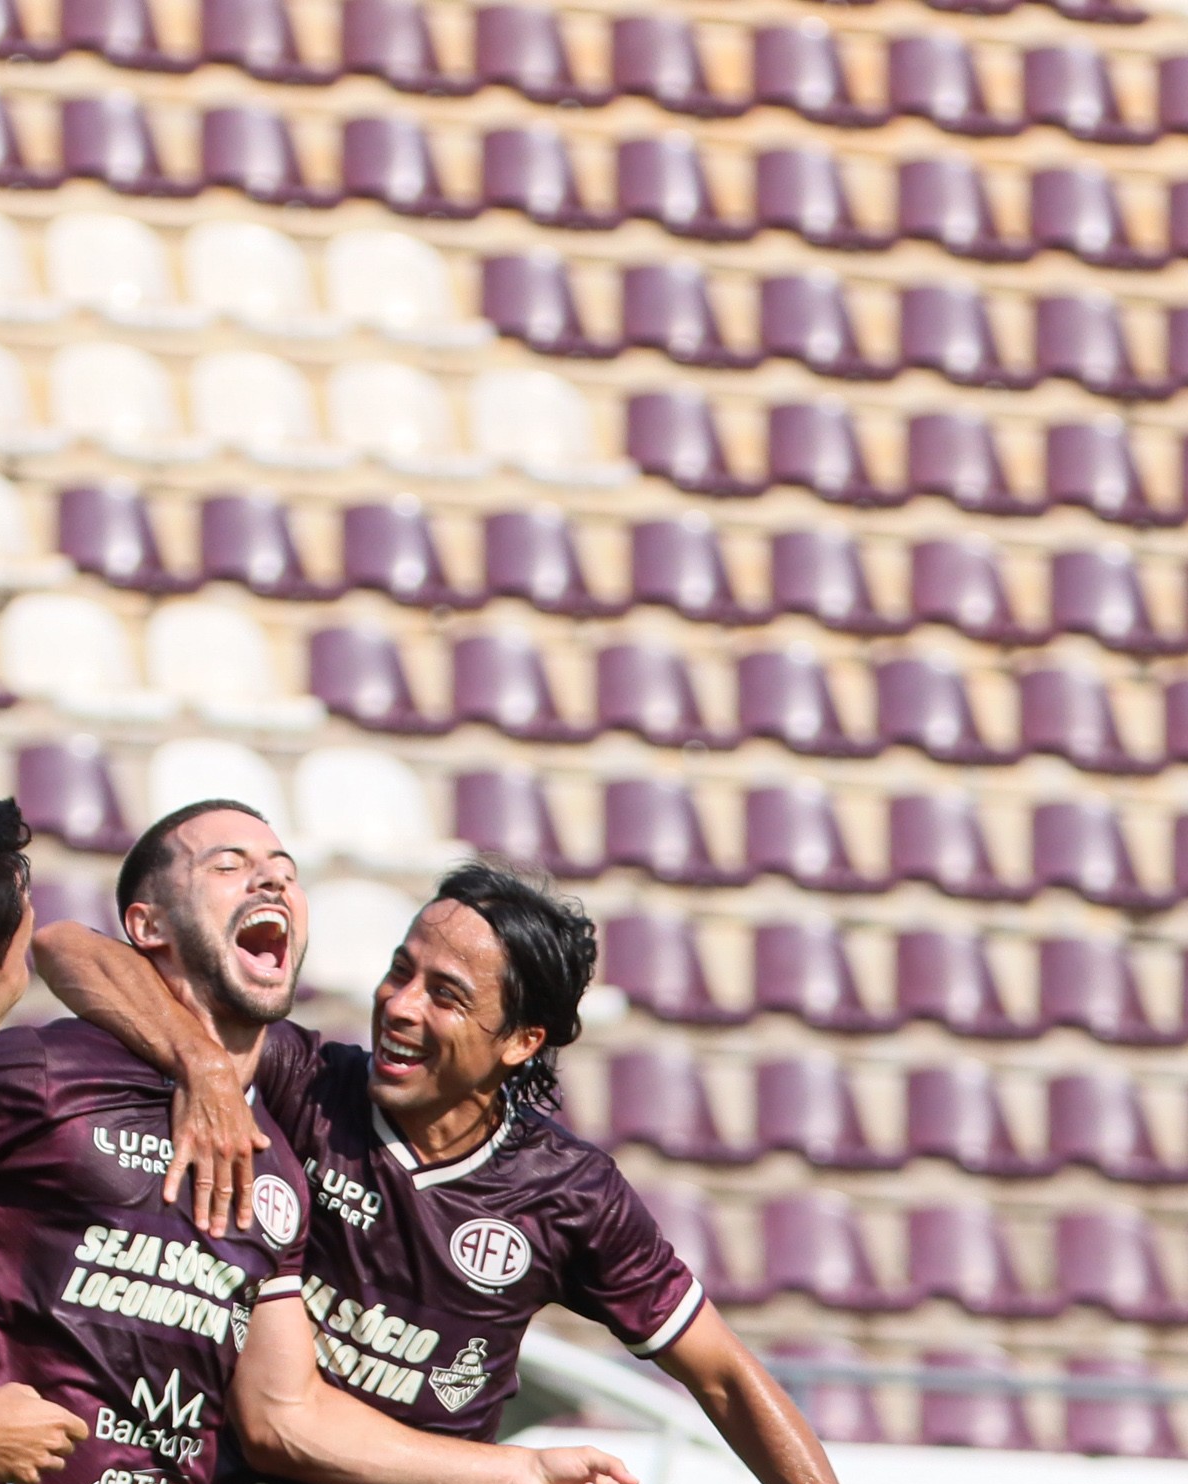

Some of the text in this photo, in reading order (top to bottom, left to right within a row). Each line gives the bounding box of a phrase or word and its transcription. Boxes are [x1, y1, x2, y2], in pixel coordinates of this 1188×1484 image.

[93, 1127, 174, 1160] LUPO
[118, 1153, 171, 1174] SPOR
[316, 1191, 376, 1231] SPORT
[74, 1225, 246, 1300] SEJA SÓCIO
[459, 1227, 521, 1275] AFE
[327, 1298, 440, 1364] SÓCIO
